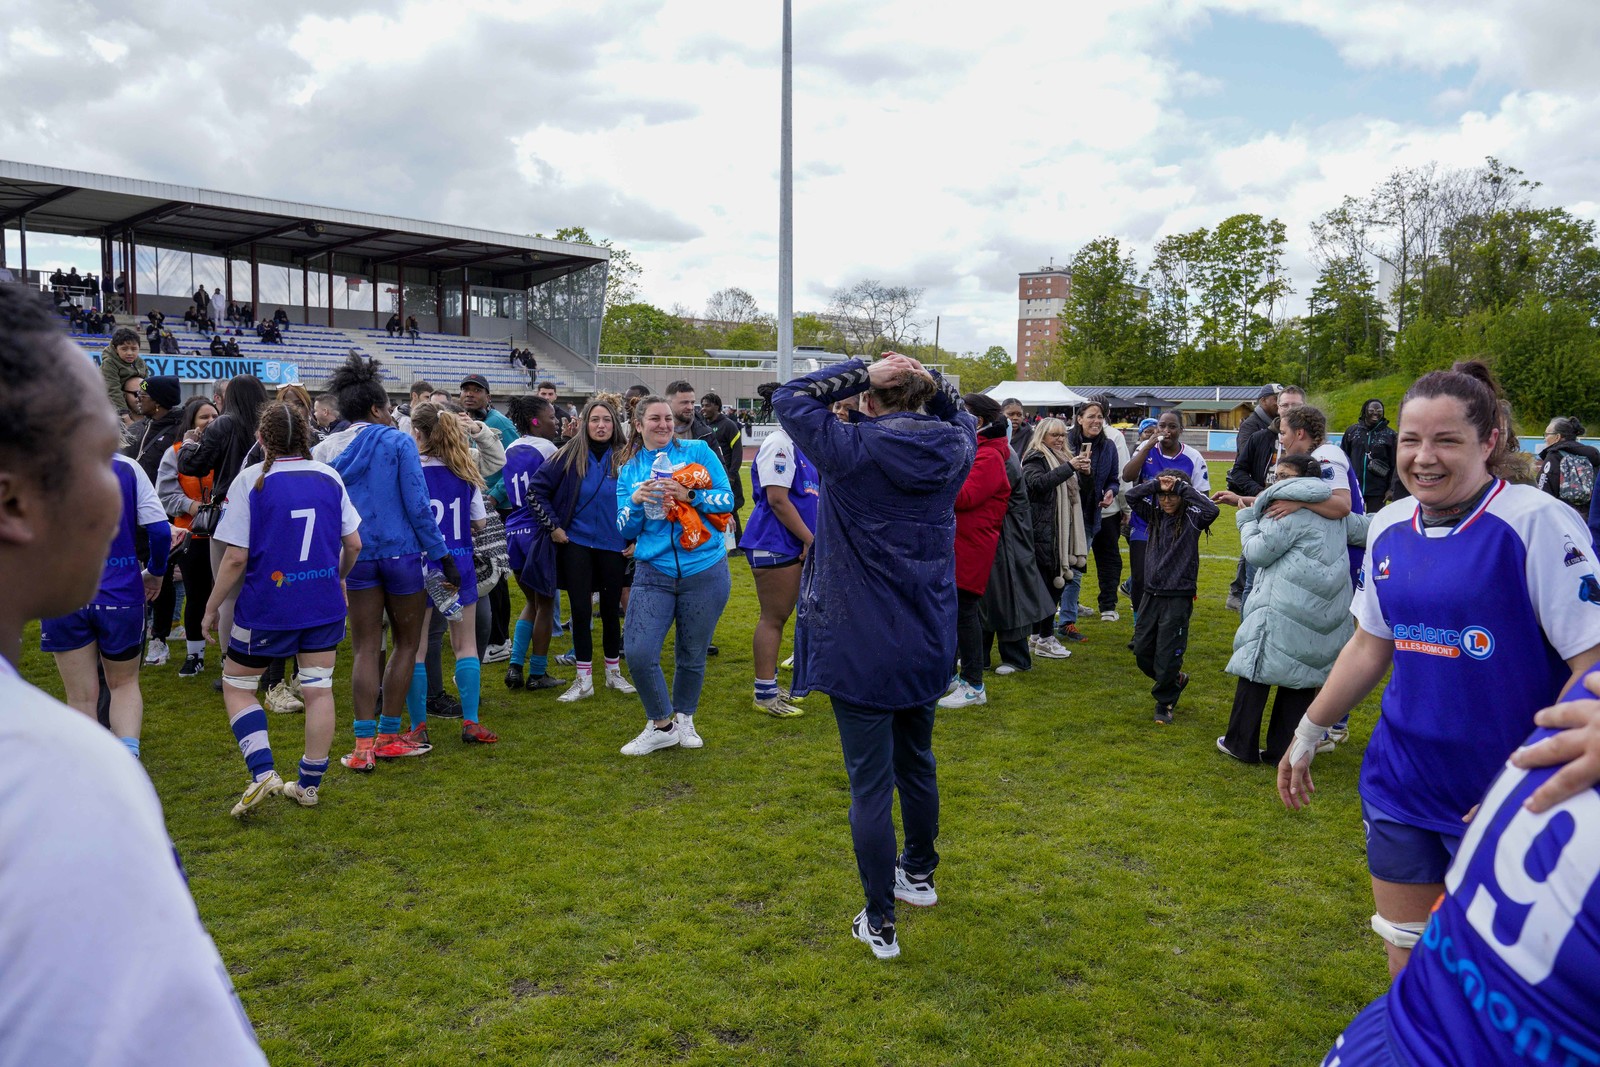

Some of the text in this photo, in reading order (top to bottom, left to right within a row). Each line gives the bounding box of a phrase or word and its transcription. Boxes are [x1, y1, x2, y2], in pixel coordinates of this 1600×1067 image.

[174, 359, 263, 380] ESSONNE
[511, 471, 530, 507] 11
[290, 508, 316, 562] 7
[1394, 623, 1460, 646] eclerc
[1394, 641, 1454, 656] ELLES-DOMONT
[1445, 736, 1600, 986] 19
